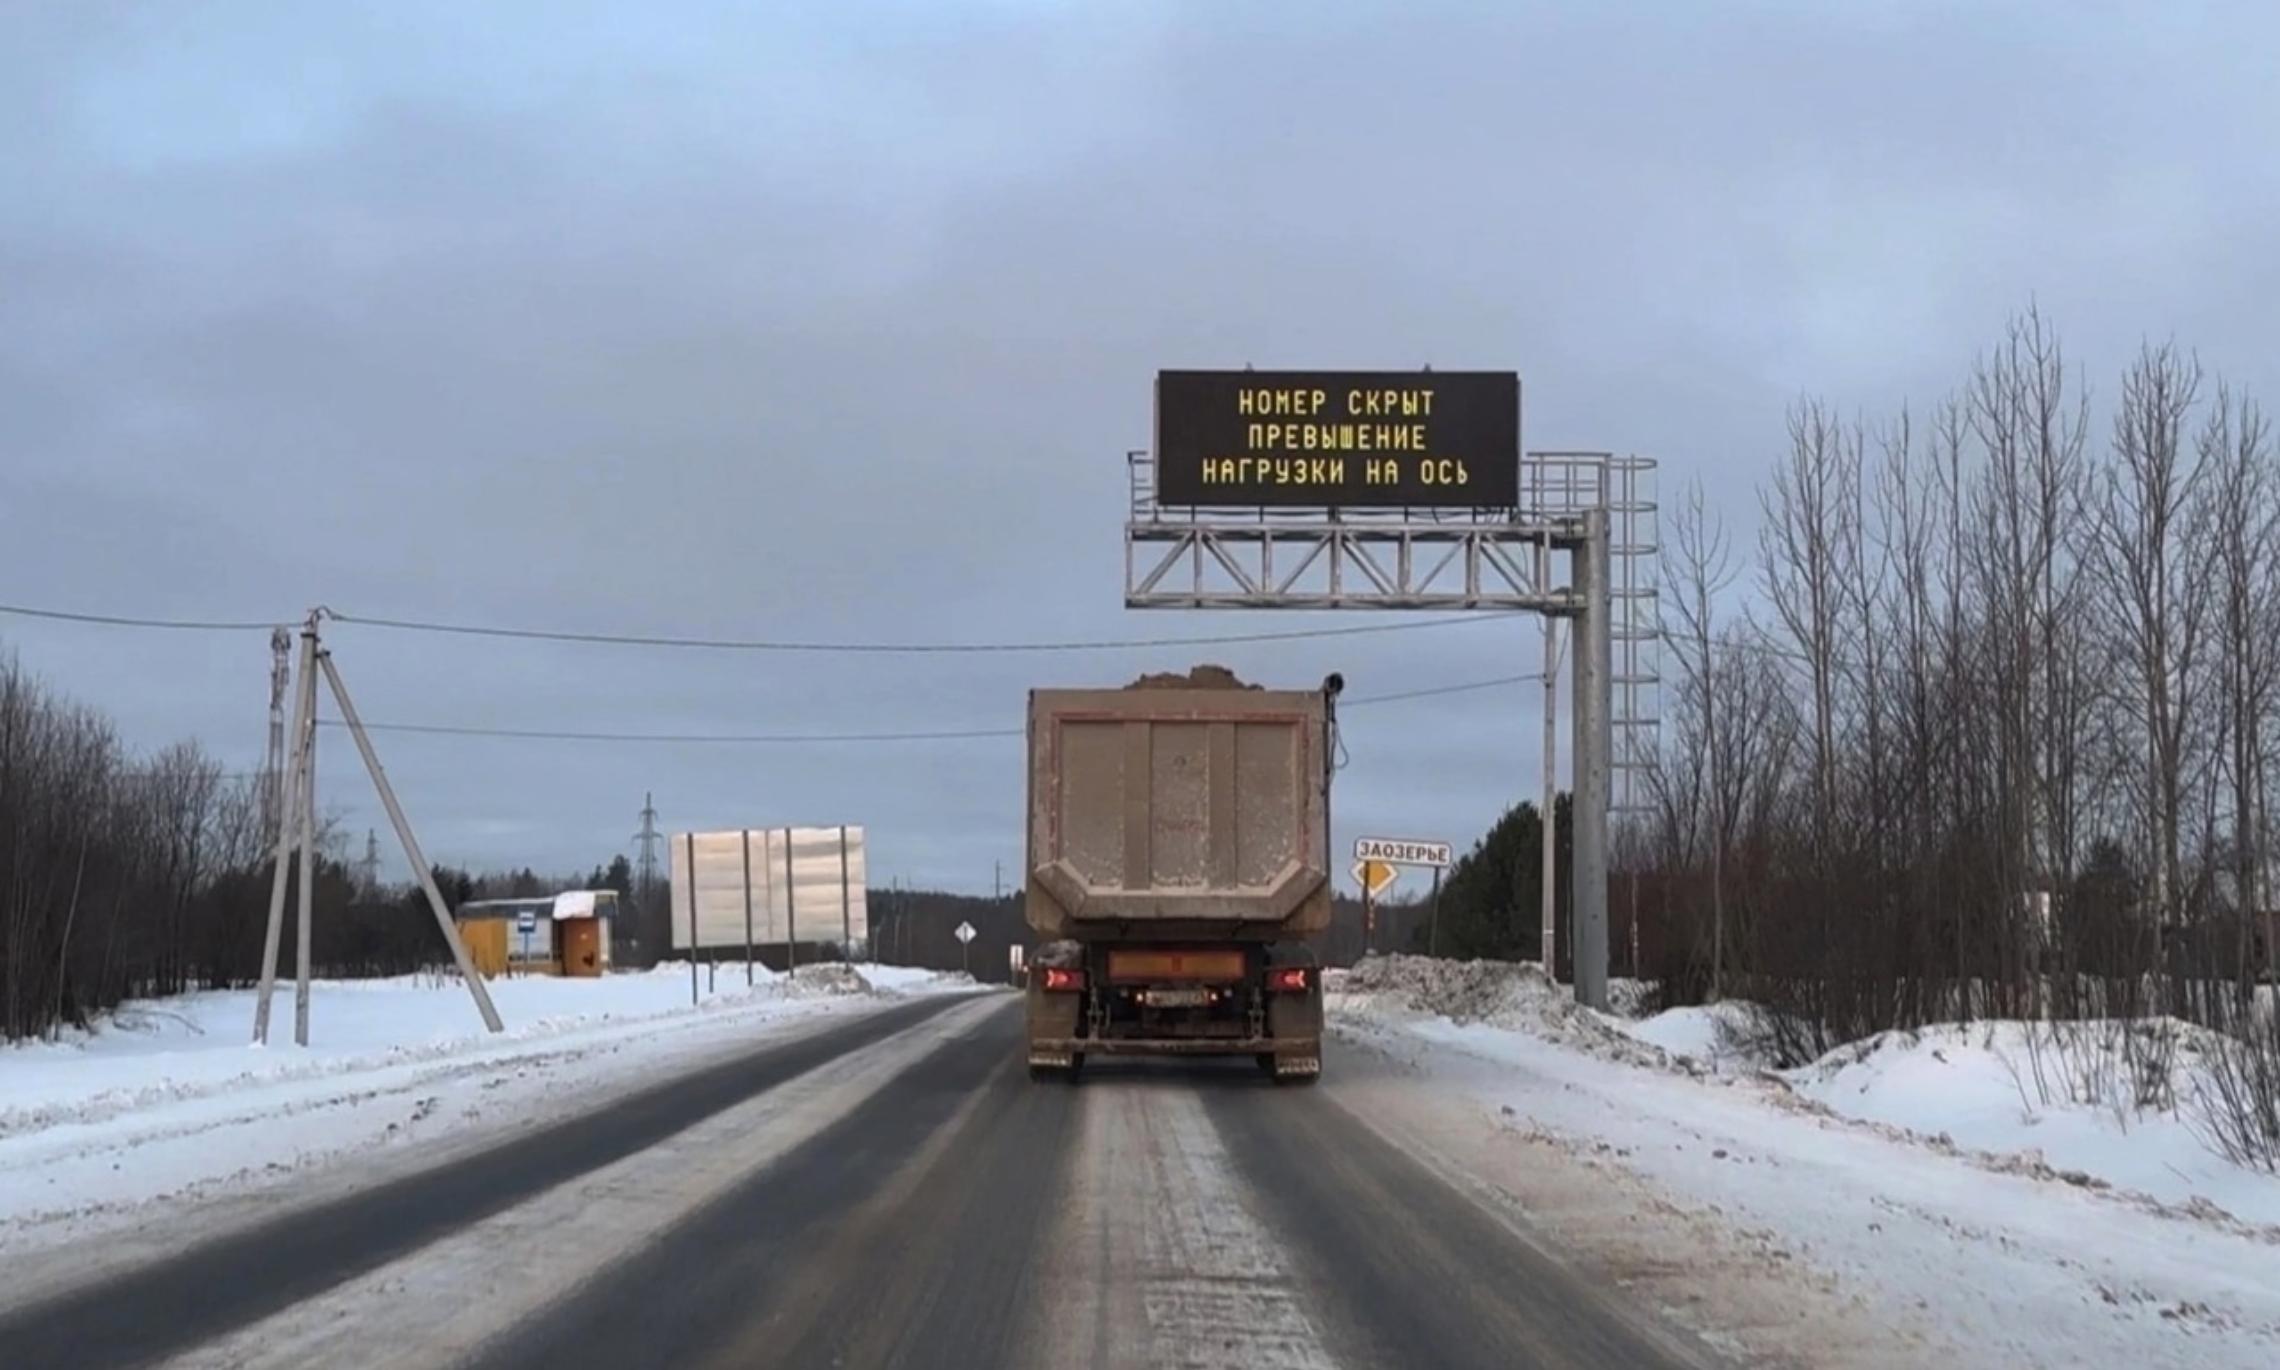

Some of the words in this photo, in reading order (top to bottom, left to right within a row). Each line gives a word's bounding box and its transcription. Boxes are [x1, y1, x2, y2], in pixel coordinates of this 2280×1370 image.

[1239, 389, 1327, 415] НОМЕР
[1348, 390, 1434, 416] СКРЫТ
[1248, 424, 1427, 450] ПРЕВЫШЕНИЕ
[1202, 458, 1344, 484] НАГРУЗКИ
[1366, 459, 1399, 484] НА
[1420, 460, 1468, 485] ОСЬ
[1360, 842, 1447, 862] ЗАОЗЕРЬЕ
